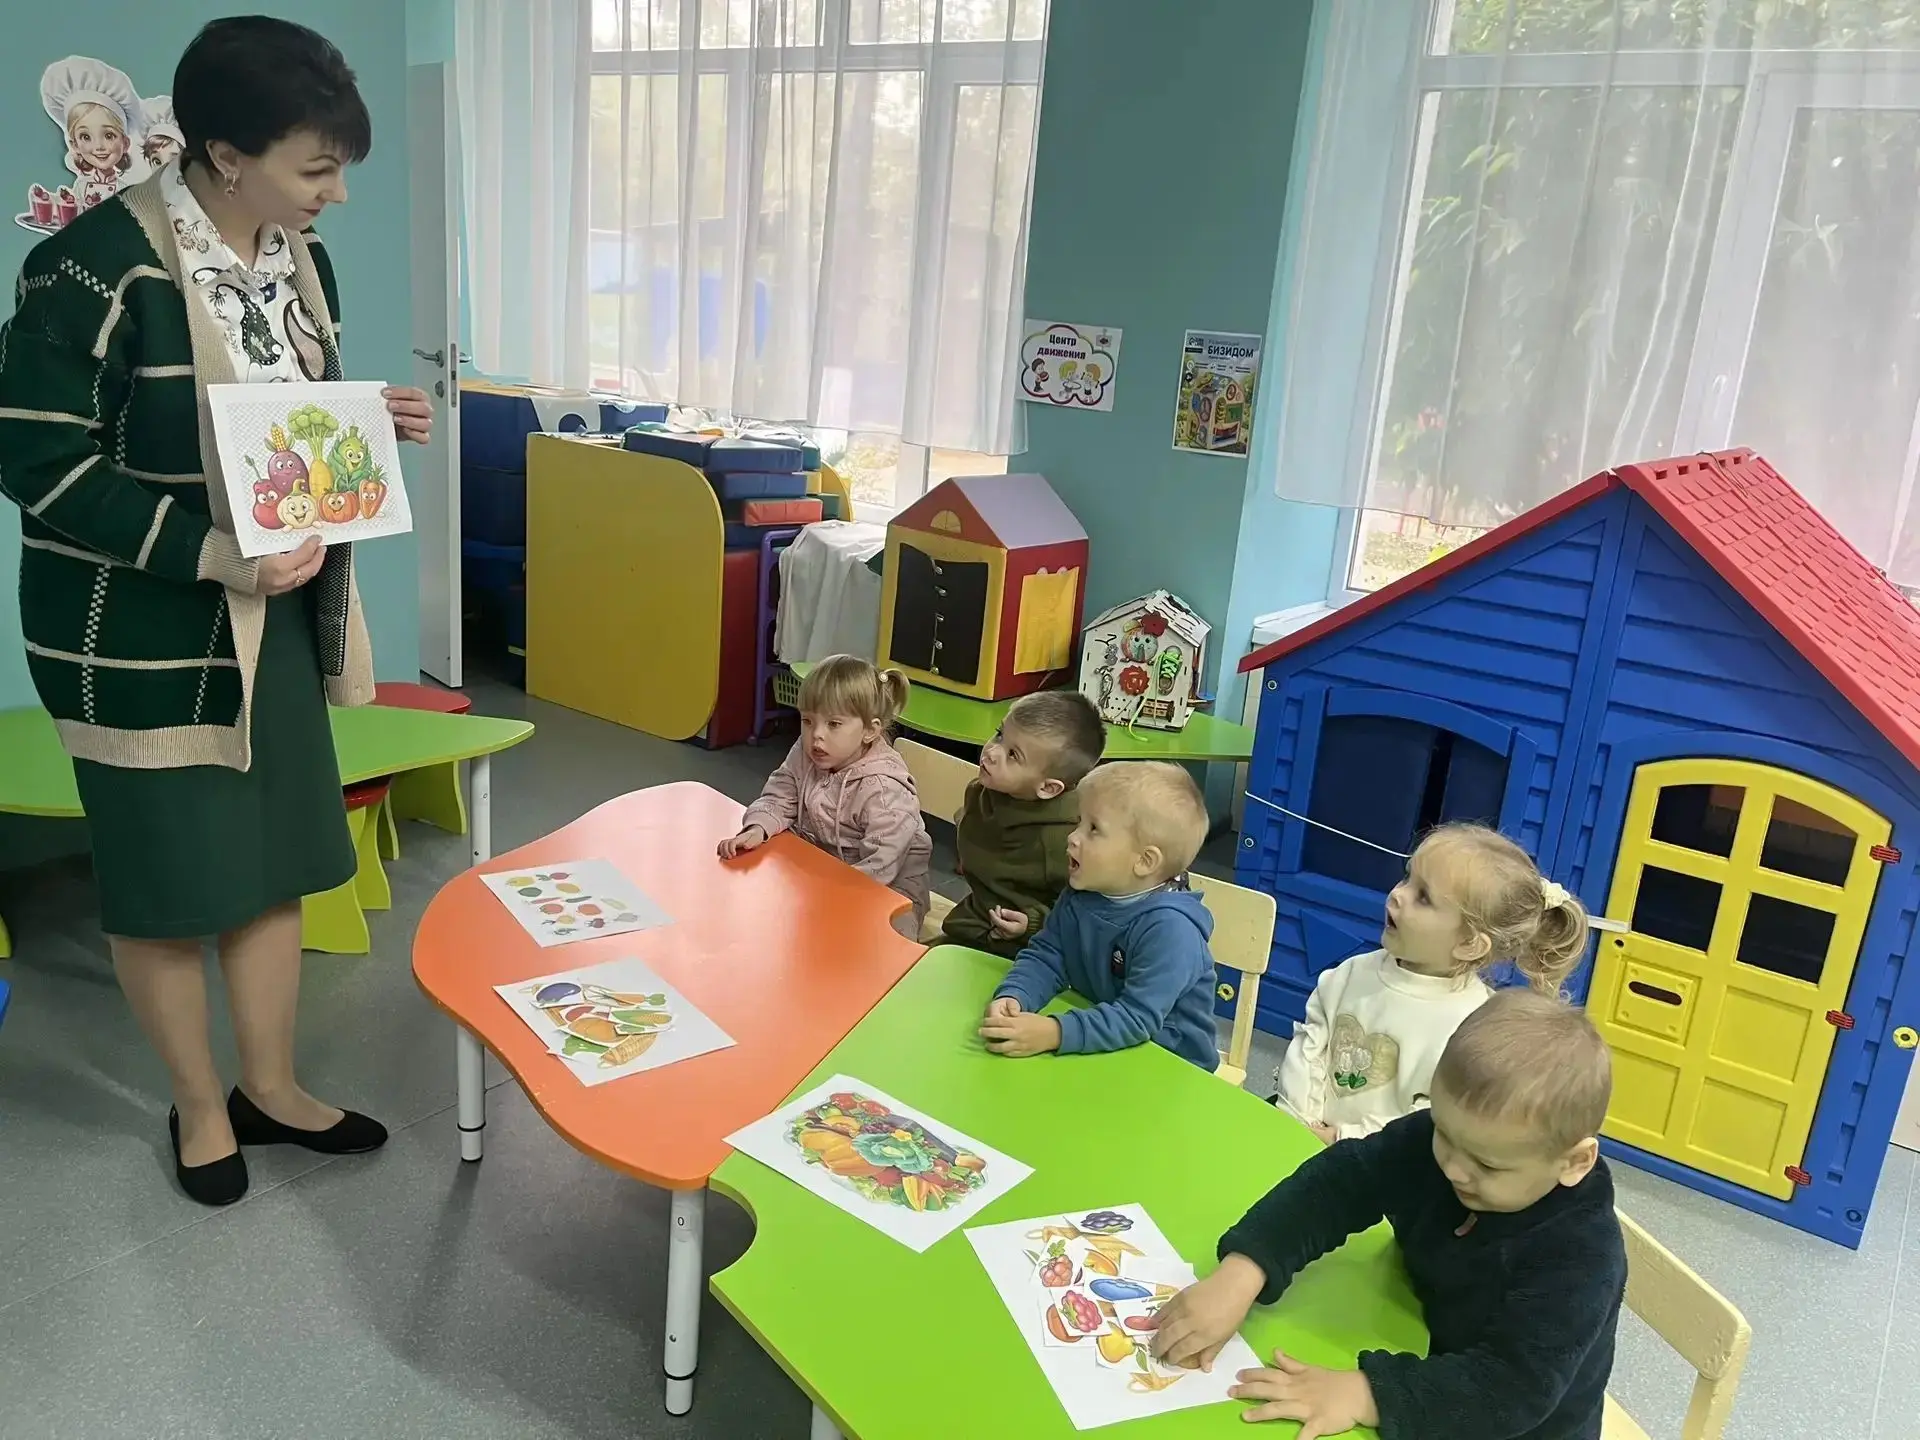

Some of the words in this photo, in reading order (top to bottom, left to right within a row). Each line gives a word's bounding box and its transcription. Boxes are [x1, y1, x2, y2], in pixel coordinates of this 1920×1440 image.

[1049, 334, 1077, 347] Центр
[1037, 347, 1086, 360] движения
[1207, 345, 1255, 358] БИЗИДОМ
